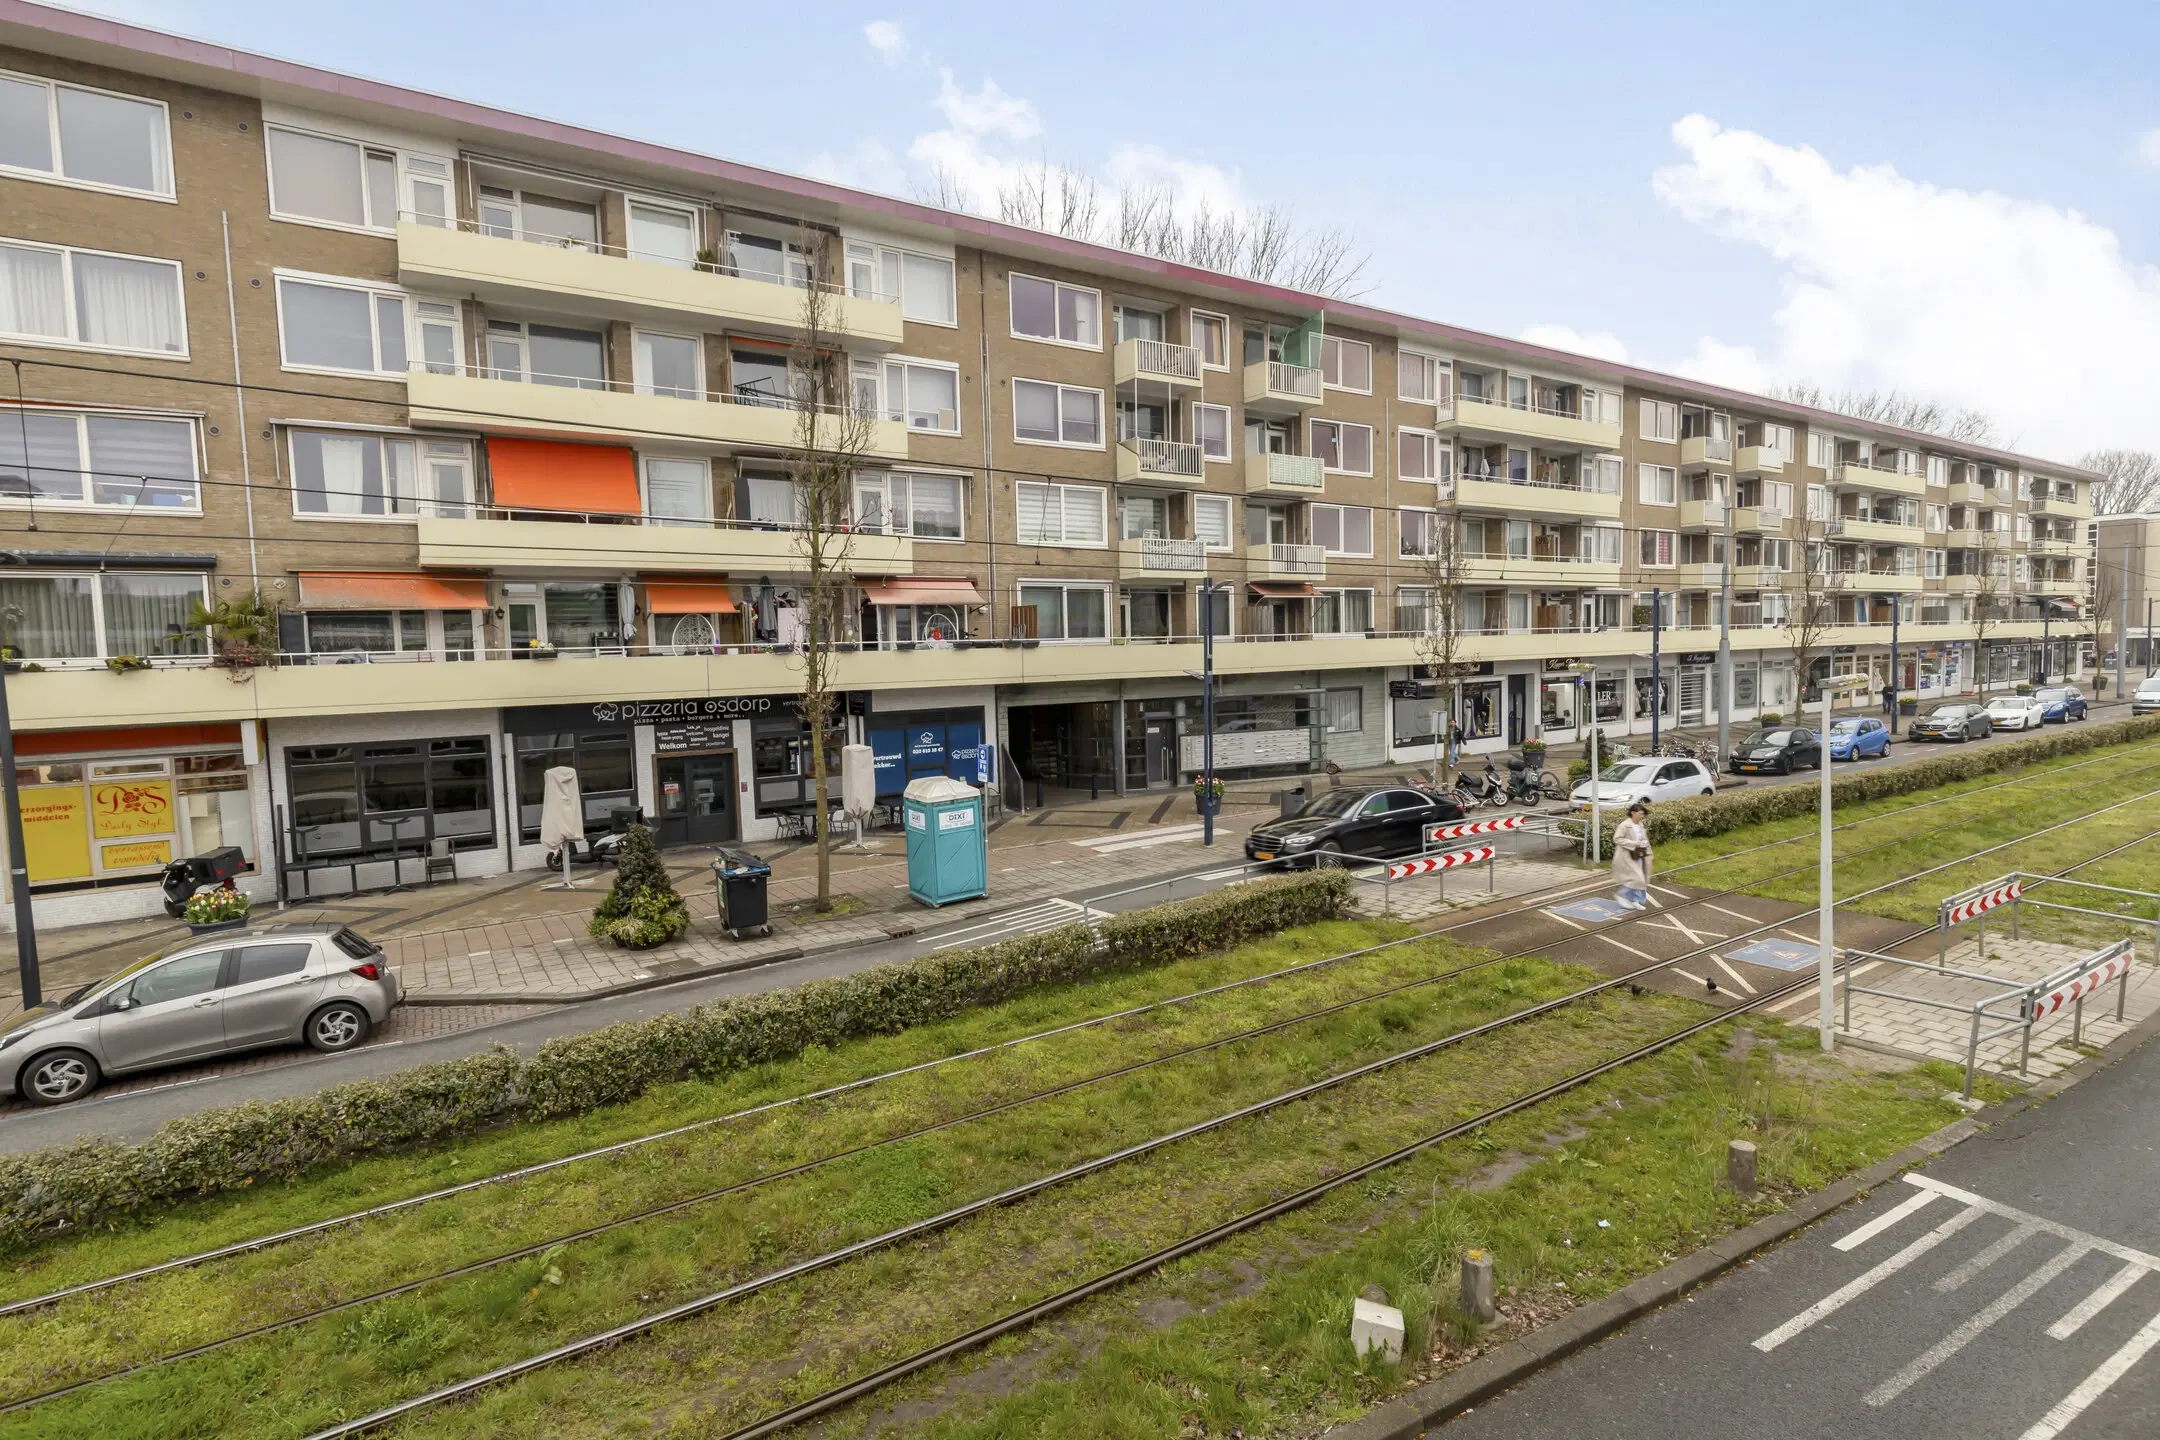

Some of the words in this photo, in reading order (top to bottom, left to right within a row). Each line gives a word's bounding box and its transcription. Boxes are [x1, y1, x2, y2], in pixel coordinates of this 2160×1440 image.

[1597, 691, 1611, 701] LER
[622, 700, 698, 720] pizzeria
[705, 697, 771, 713] osdorp
[659, 742, 687, 750] Welkom
[20, 804, 76, 814] erzorgings-
